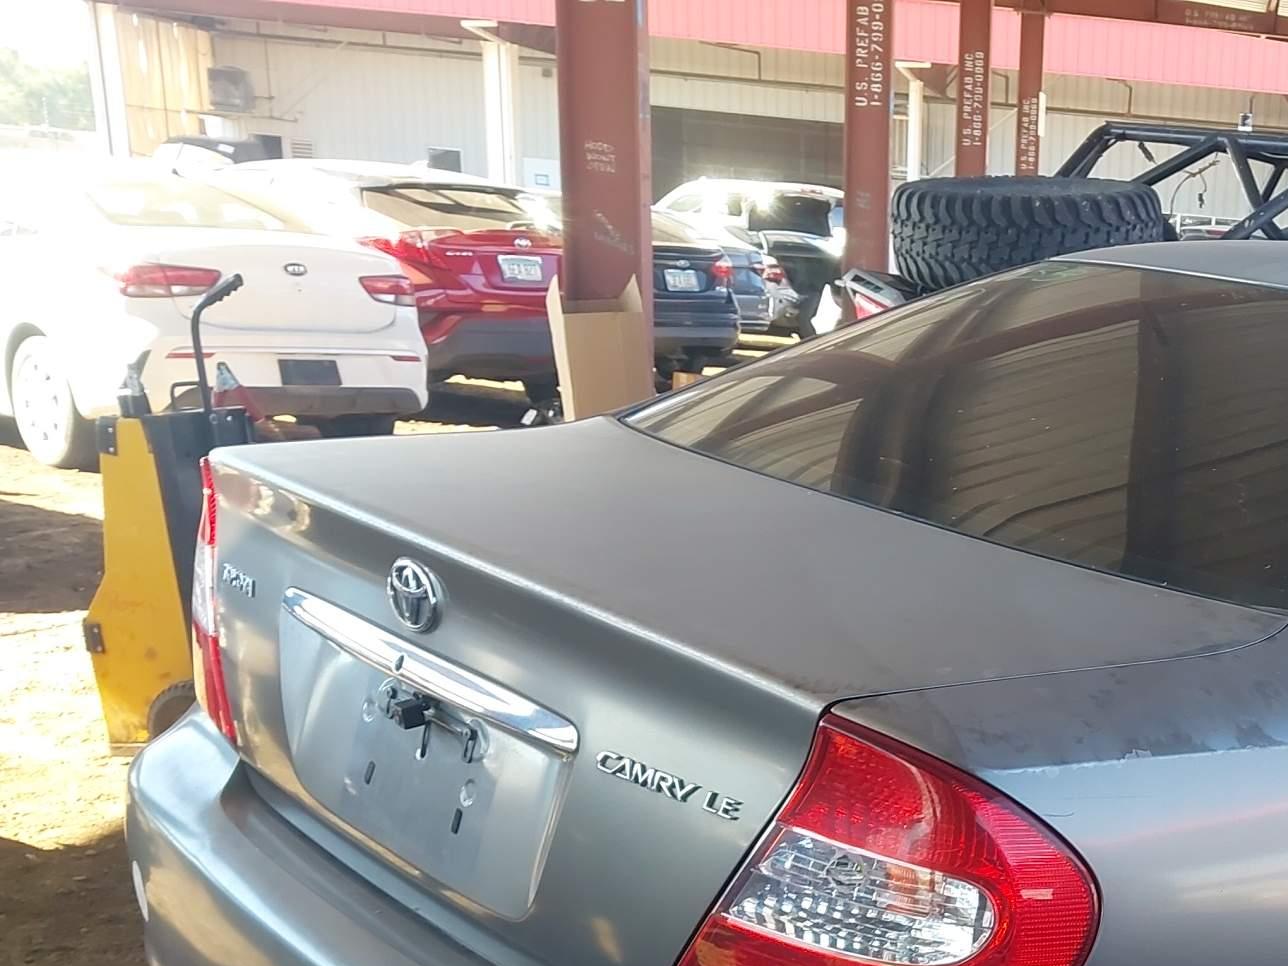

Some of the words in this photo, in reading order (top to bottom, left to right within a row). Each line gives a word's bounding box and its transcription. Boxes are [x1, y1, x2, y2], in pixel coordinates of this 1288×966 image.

[855, 5, 870, 68] PREFAB
[869, 0, 885, 106] 1-866-799-0
[963, 76, 974, 120] PREFAB
[596, 751, 702, 802] CAMRY
[702, 791, 744, 820] LE
